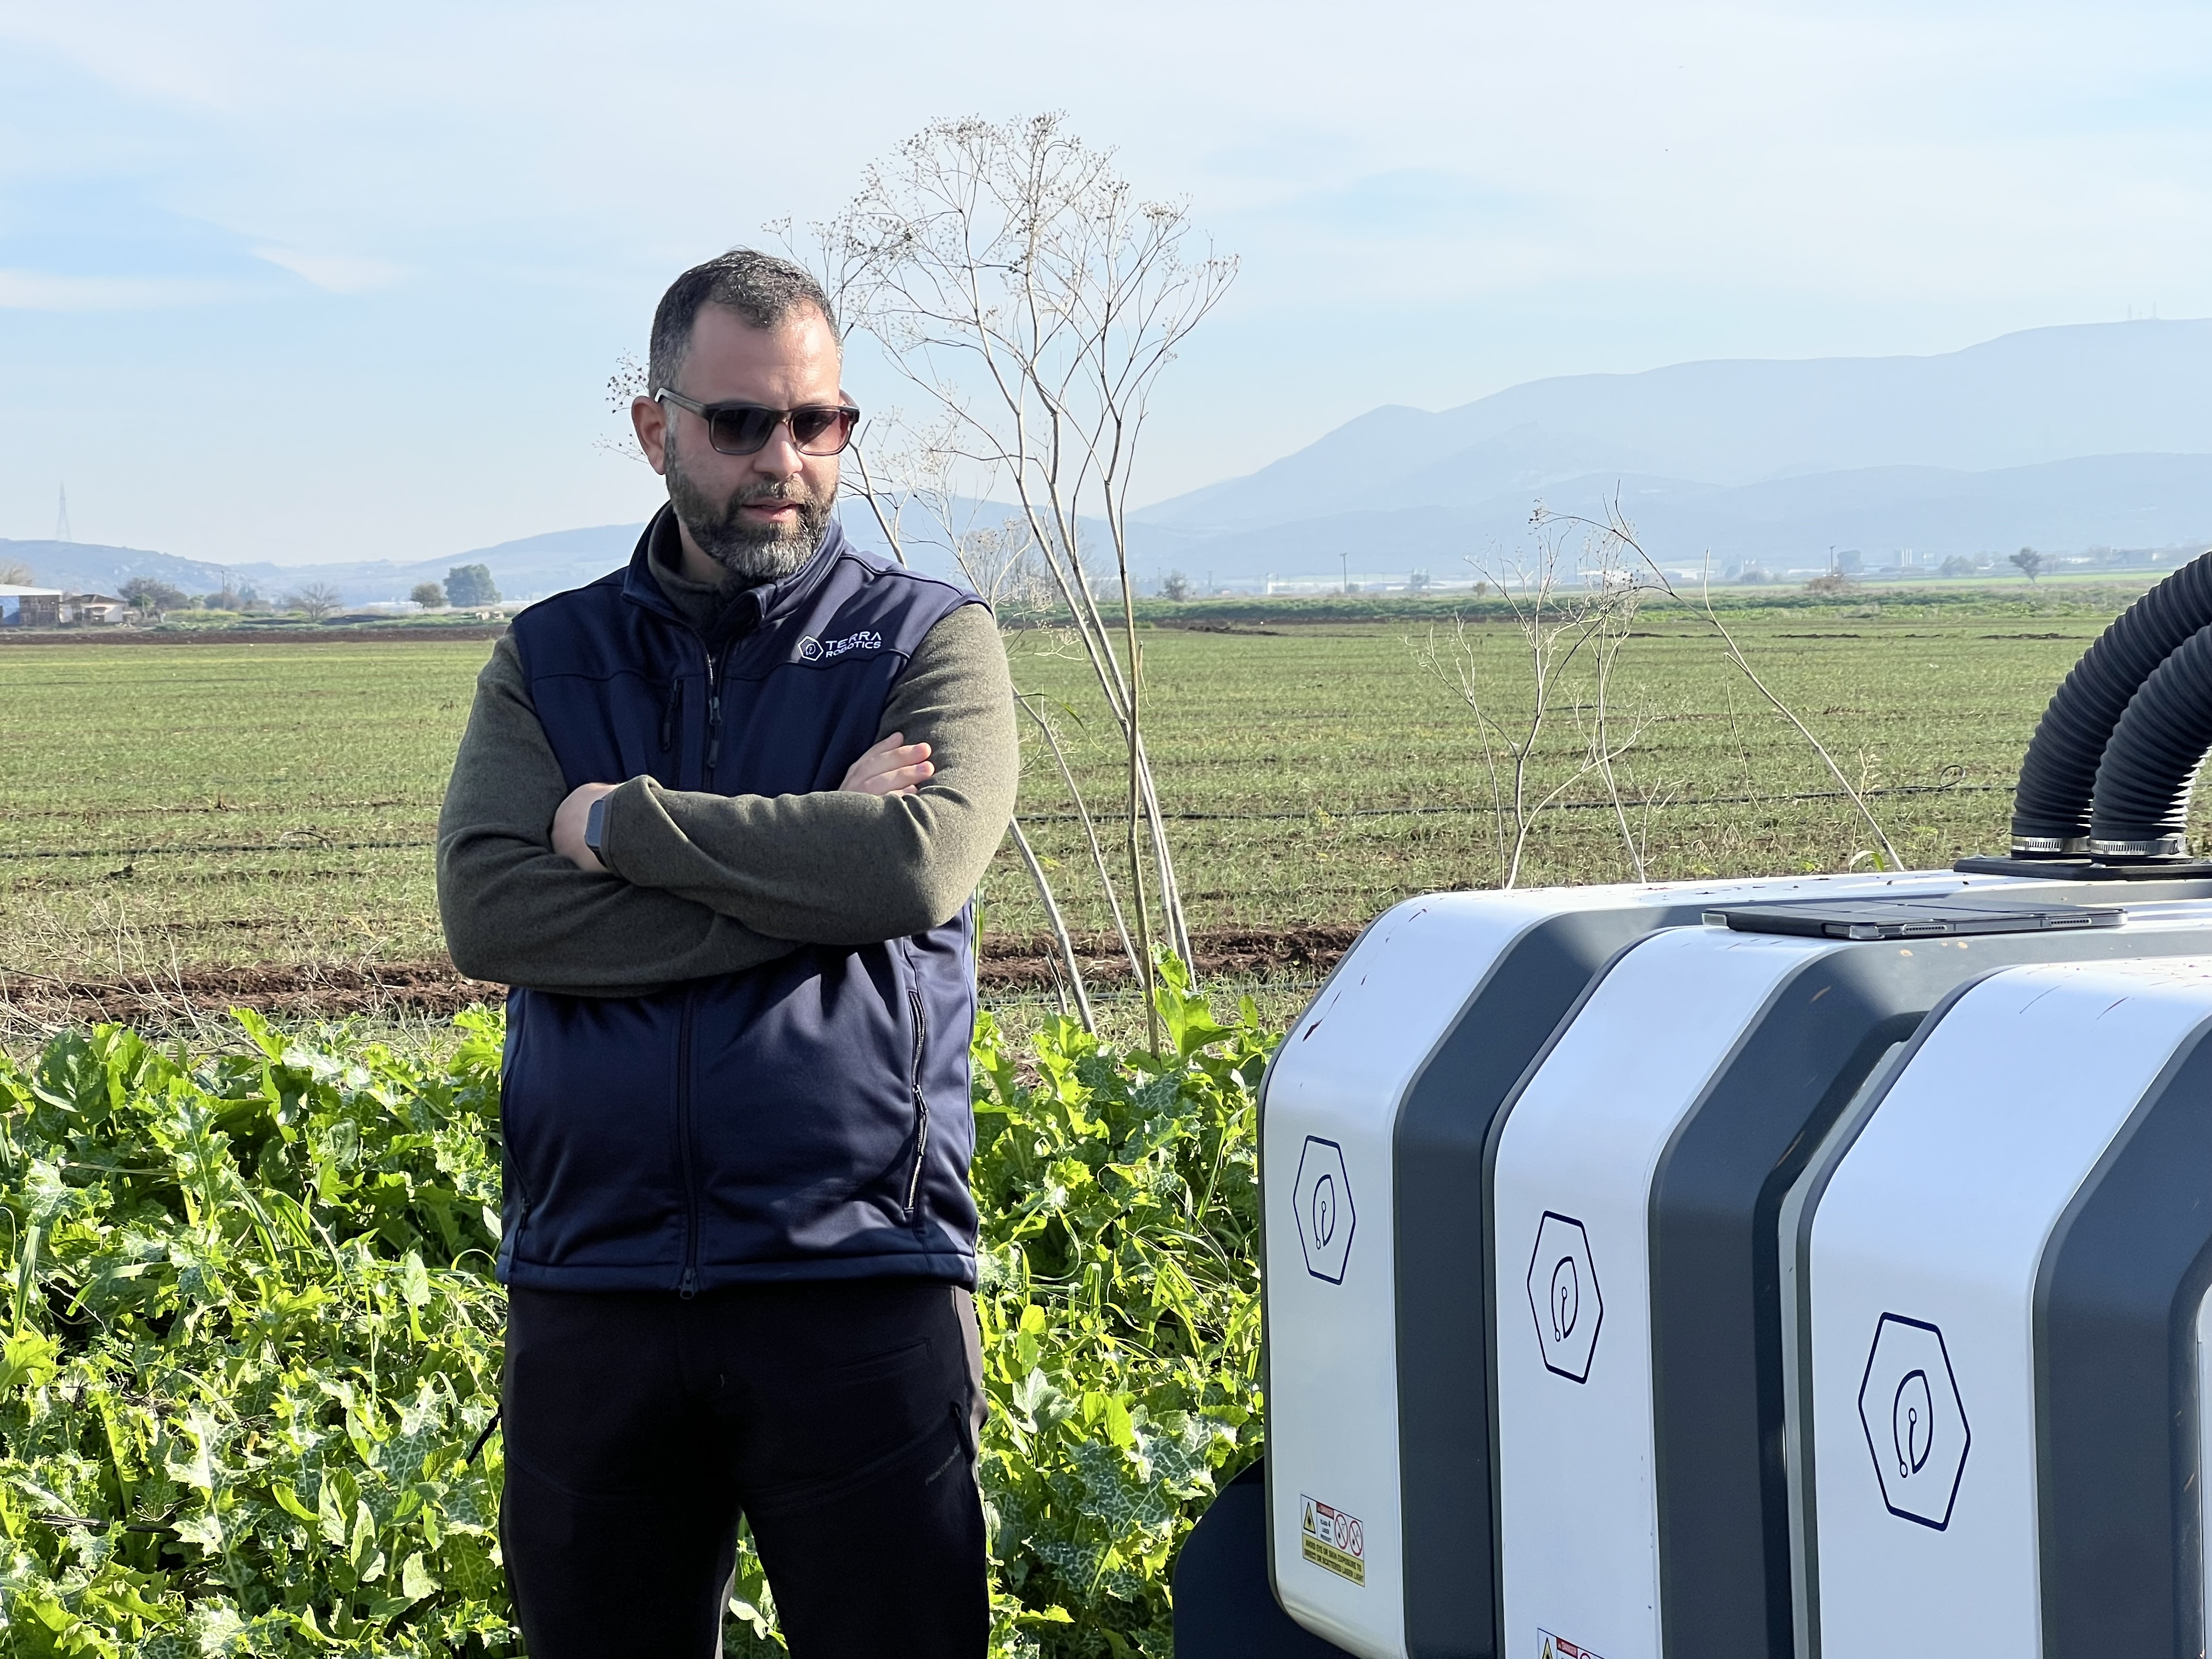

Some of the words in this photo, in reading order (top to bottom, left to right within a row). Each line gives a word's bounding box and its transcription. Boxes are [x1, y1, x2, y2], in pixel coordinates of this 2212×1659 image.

[825, 631, 882, 650] TERRA
[826, 641, 882, 658] ROBOTICS
[1304, 1548, 1316, 1560] DIRECT
[1322, 1557, 1341, 1572] SCATTERED
[1342, 1566, 1353, 1578] LASER
[1354, 1572, 1363, 1582] LIGHT
[1306, 1539, 1316, 1550] AVOID
[1329, 1550, 1337, 1560] SKIN
[1338, 1555, 1356, 1570] EXPOSURE
[1357, 1564, 1362, 1572] TO
